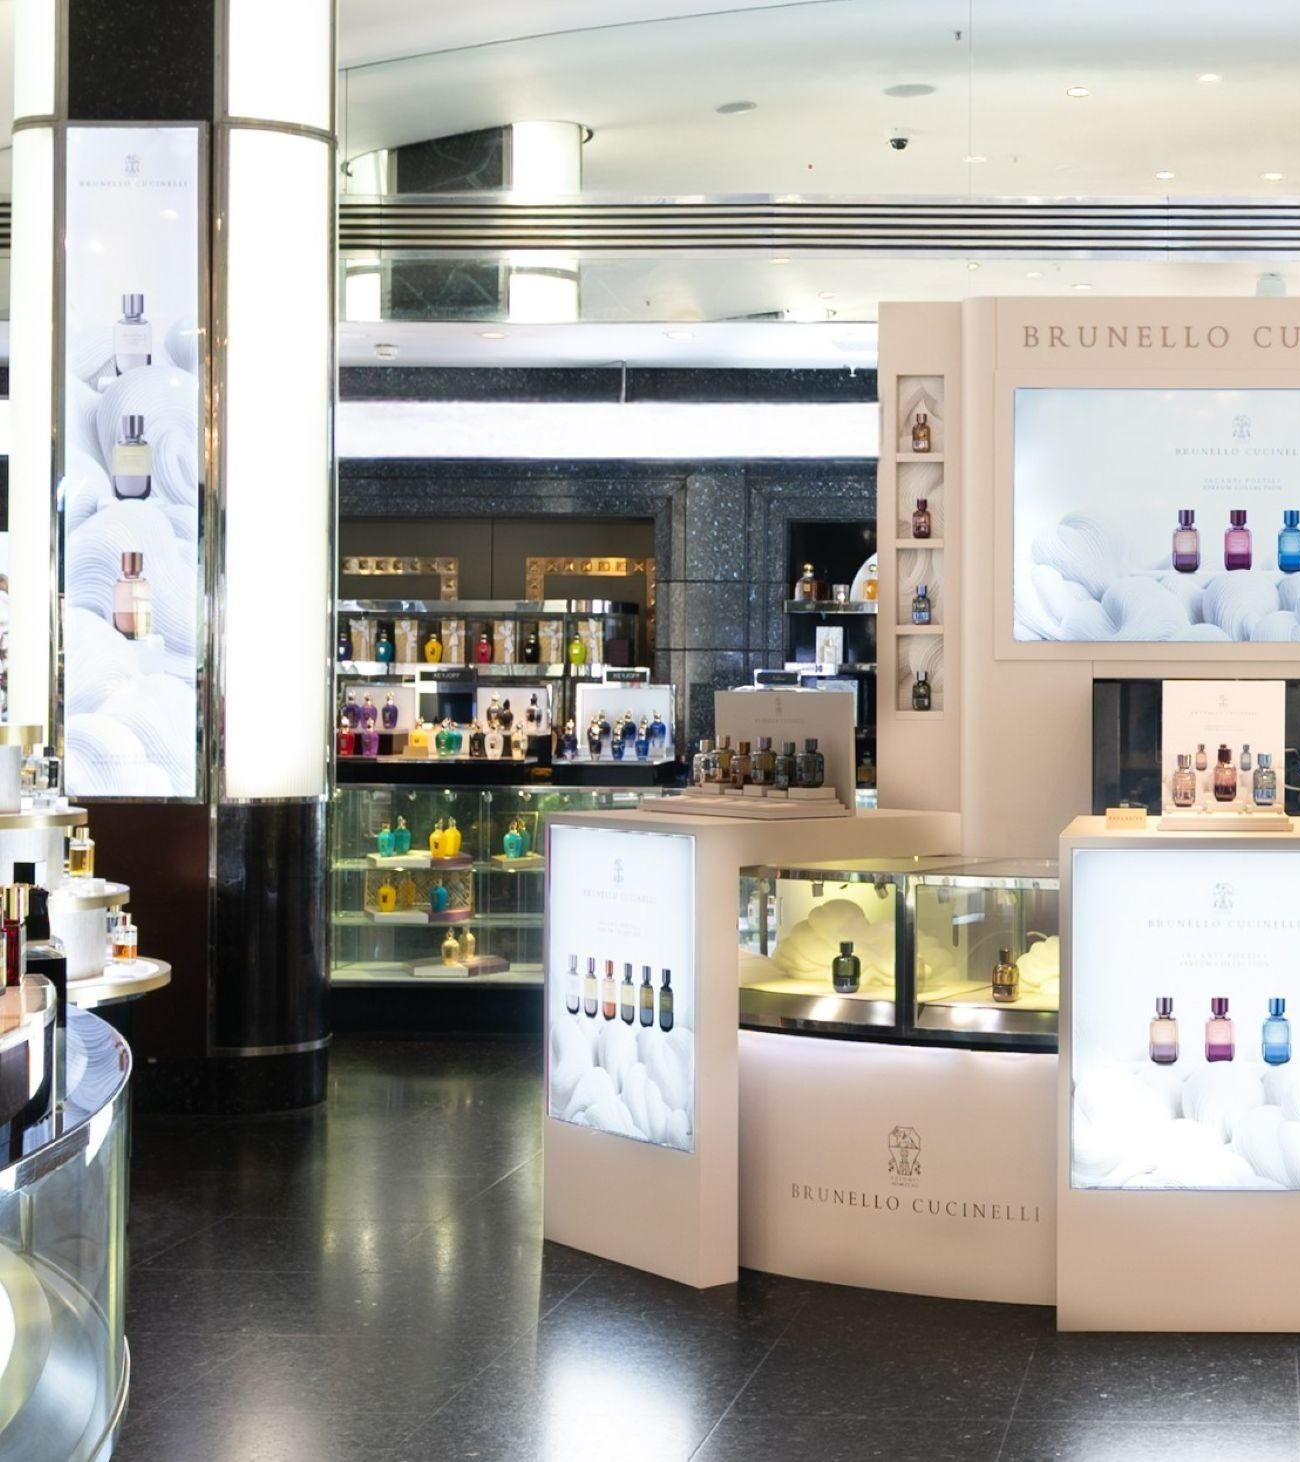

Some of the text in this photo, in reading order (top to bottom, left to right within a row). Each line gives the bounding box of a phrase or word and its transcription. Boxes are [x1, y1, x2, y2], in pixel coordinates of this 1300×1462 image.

[1022, 325, 1230, 349] BRUNELLO
[1175, 447, 1240, 456] BRUNELLO
[1148, 919, 1222, 929] BRUNELLO
[791, 1183, 1040, 1222] BRUNELLO CUCINELLI
